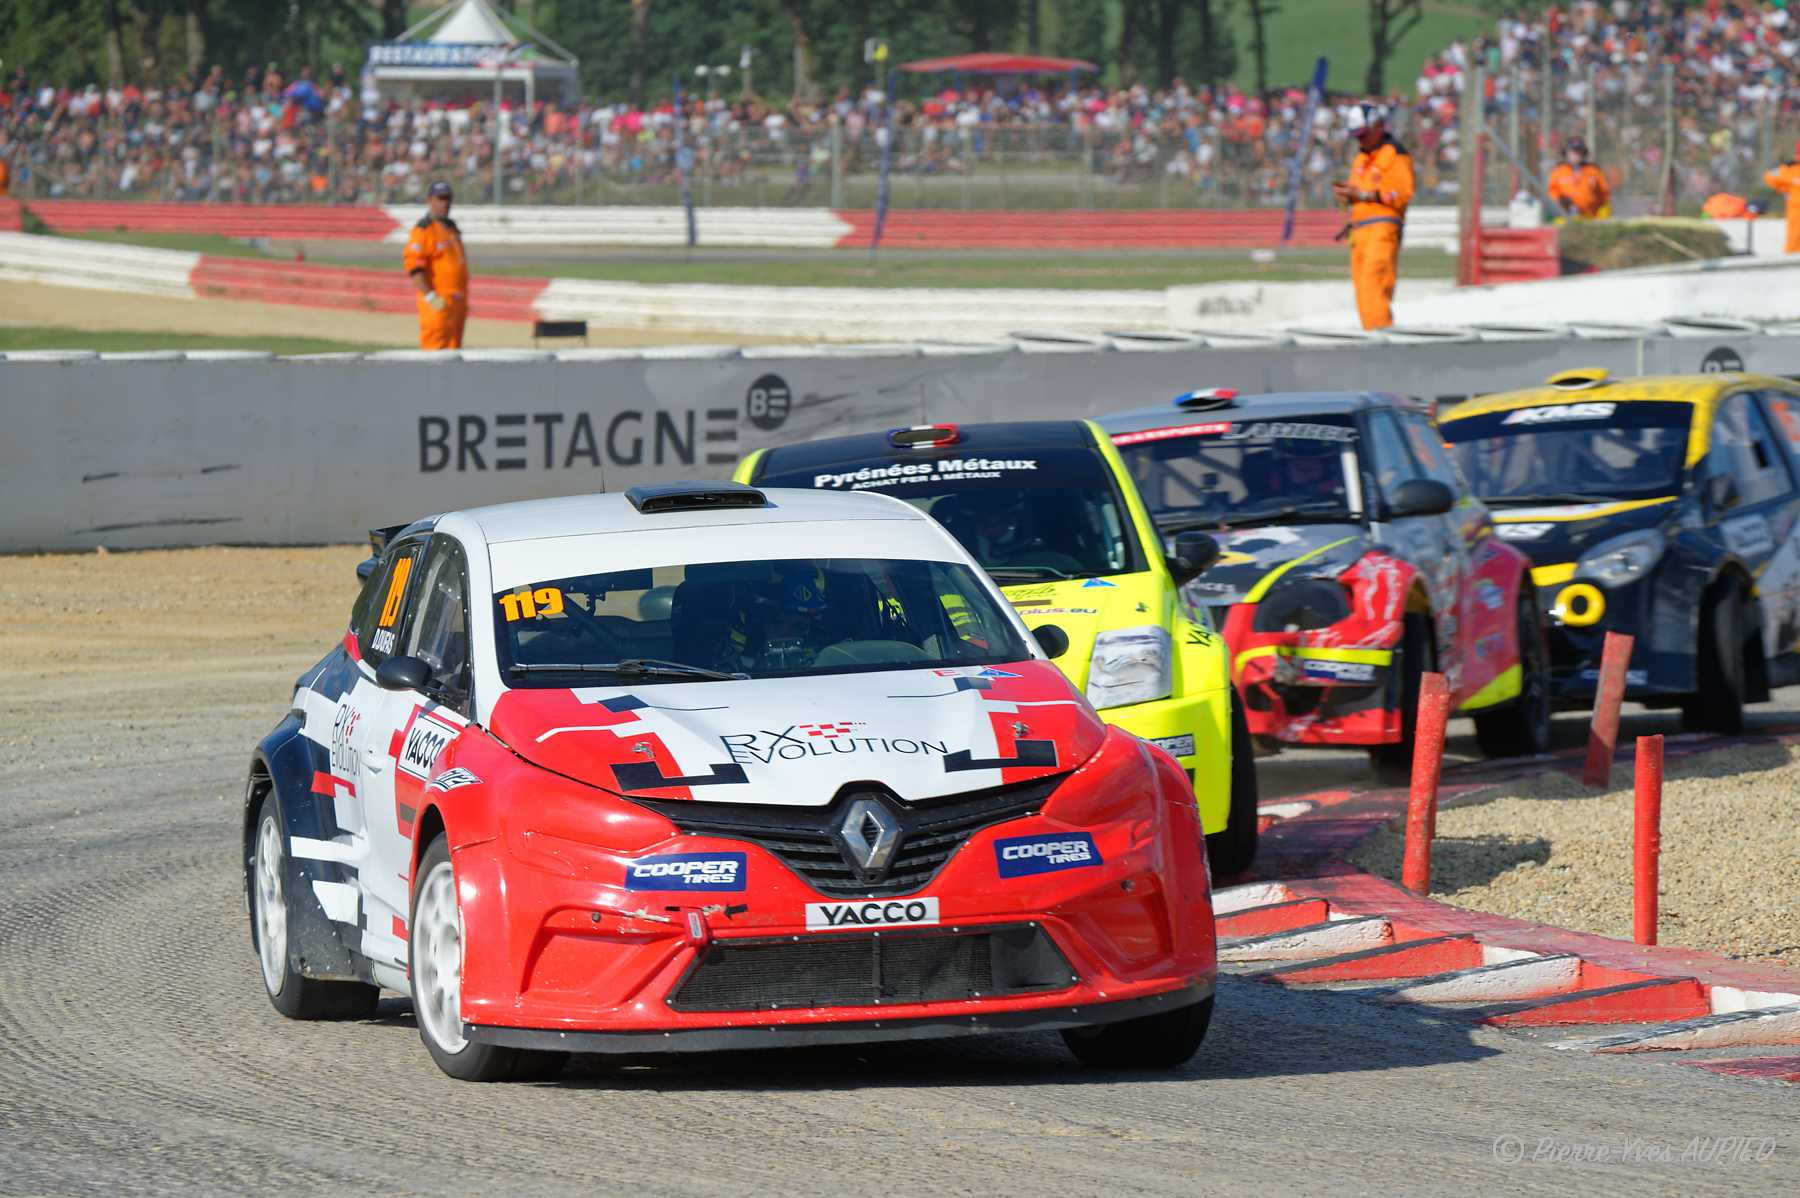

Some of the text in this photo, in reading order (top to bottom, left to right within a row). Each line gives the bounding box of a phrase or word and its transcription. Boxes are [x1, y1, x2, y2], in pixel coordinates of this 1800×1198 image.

[418, 408, 739, 473] BRETAGNE
[814, 458, 1038, 488] Pyrénées Métaux
[851, 470, 1002, 490] ACHAT FER & MÉTAUX
[499, 587, 565, 622] 119
[719, 725, 806, 752] RX
[730, 737, 949, 765] EVOLUTION
[1002, 840, 1090, 860] COOPER
[1046, 852, 1092, 865] TIRES
[633, 860, 740, 878] COOPER
[682, 873, 737, 884] TIRES
[819, 901, 927, 926] YACCO
